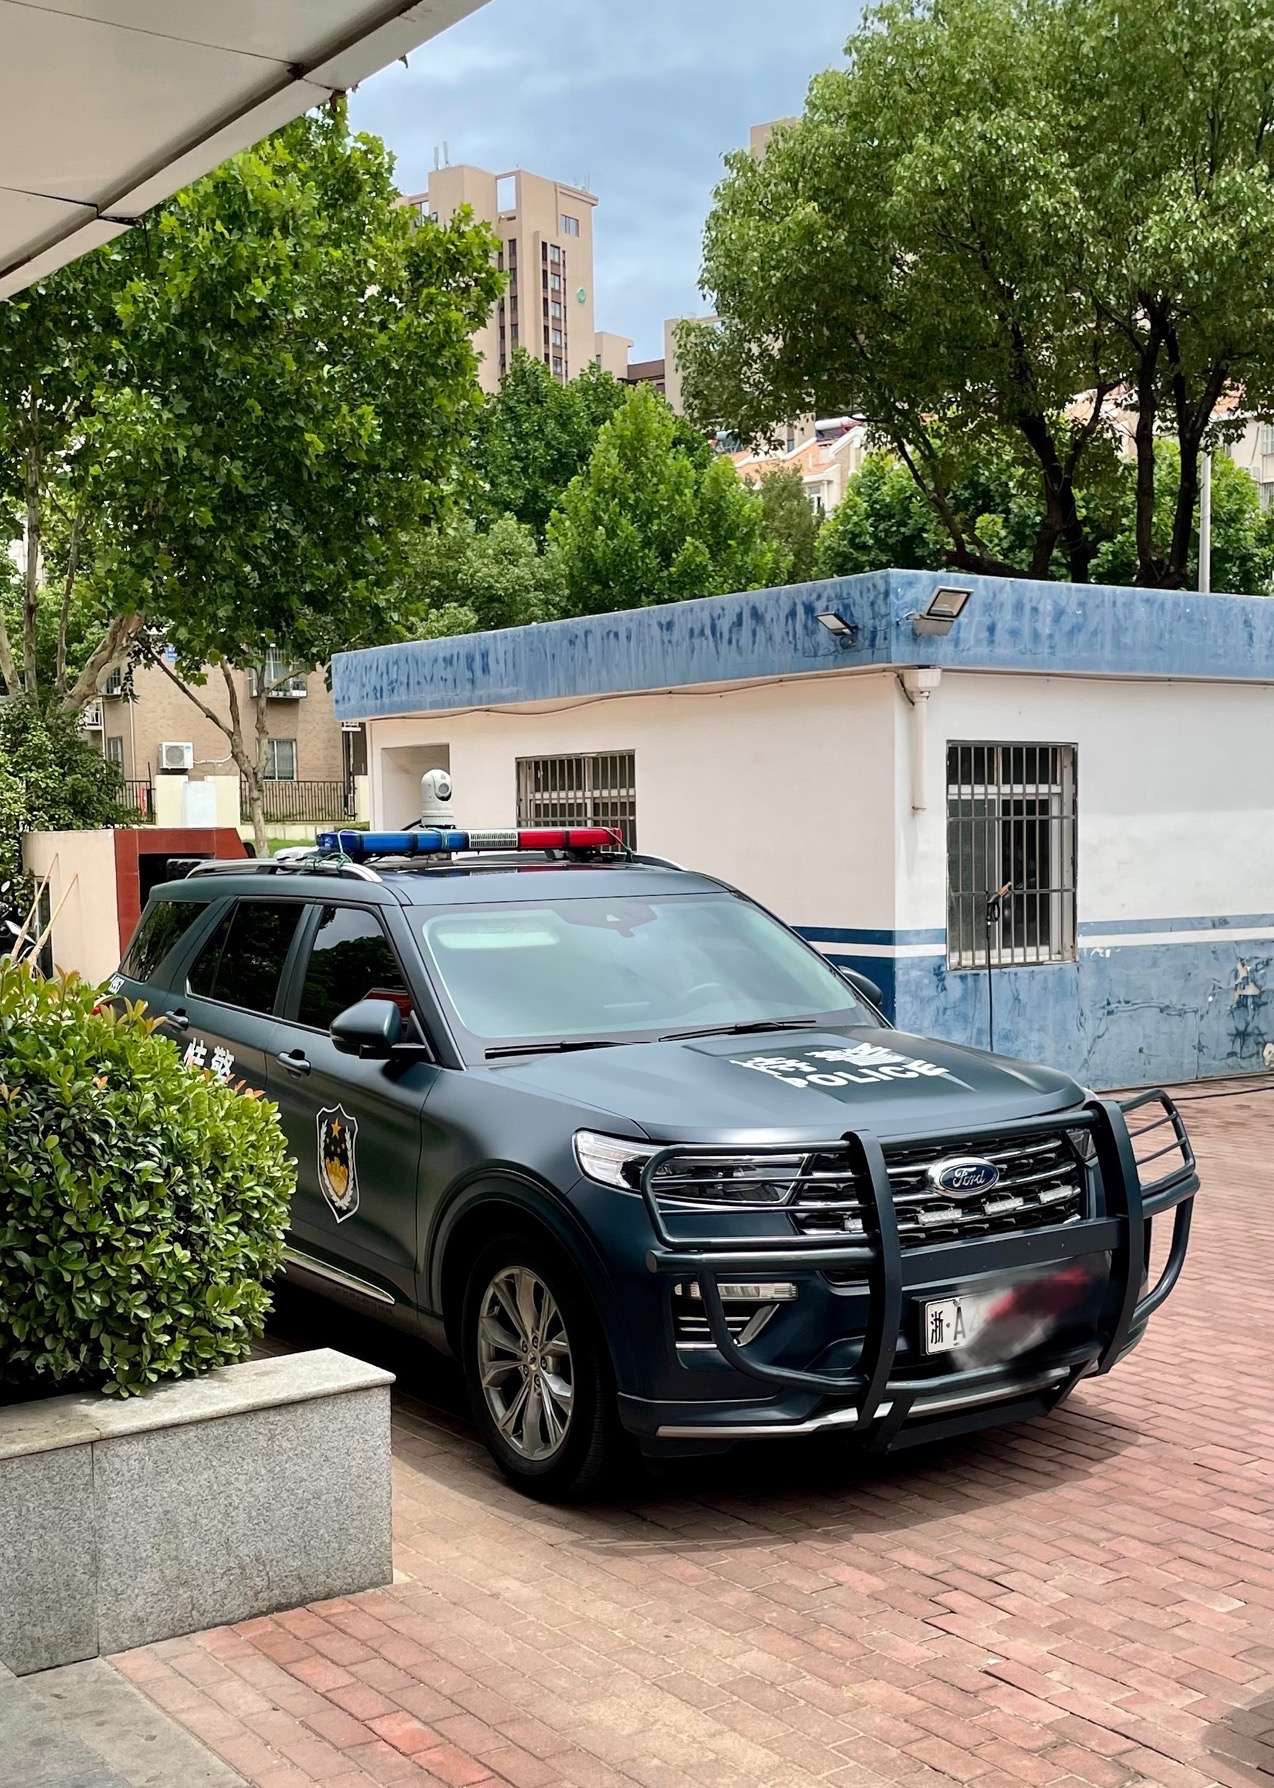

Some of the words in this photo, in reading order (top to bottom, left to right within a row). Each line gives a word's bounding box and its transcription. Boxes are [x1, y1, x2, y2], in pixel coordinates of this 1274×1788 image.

[728, 1042, 906, 1075] 特警
[773, 1060, 950, 1089] POLICE
[952, 1166, 985, 1188] Ford
